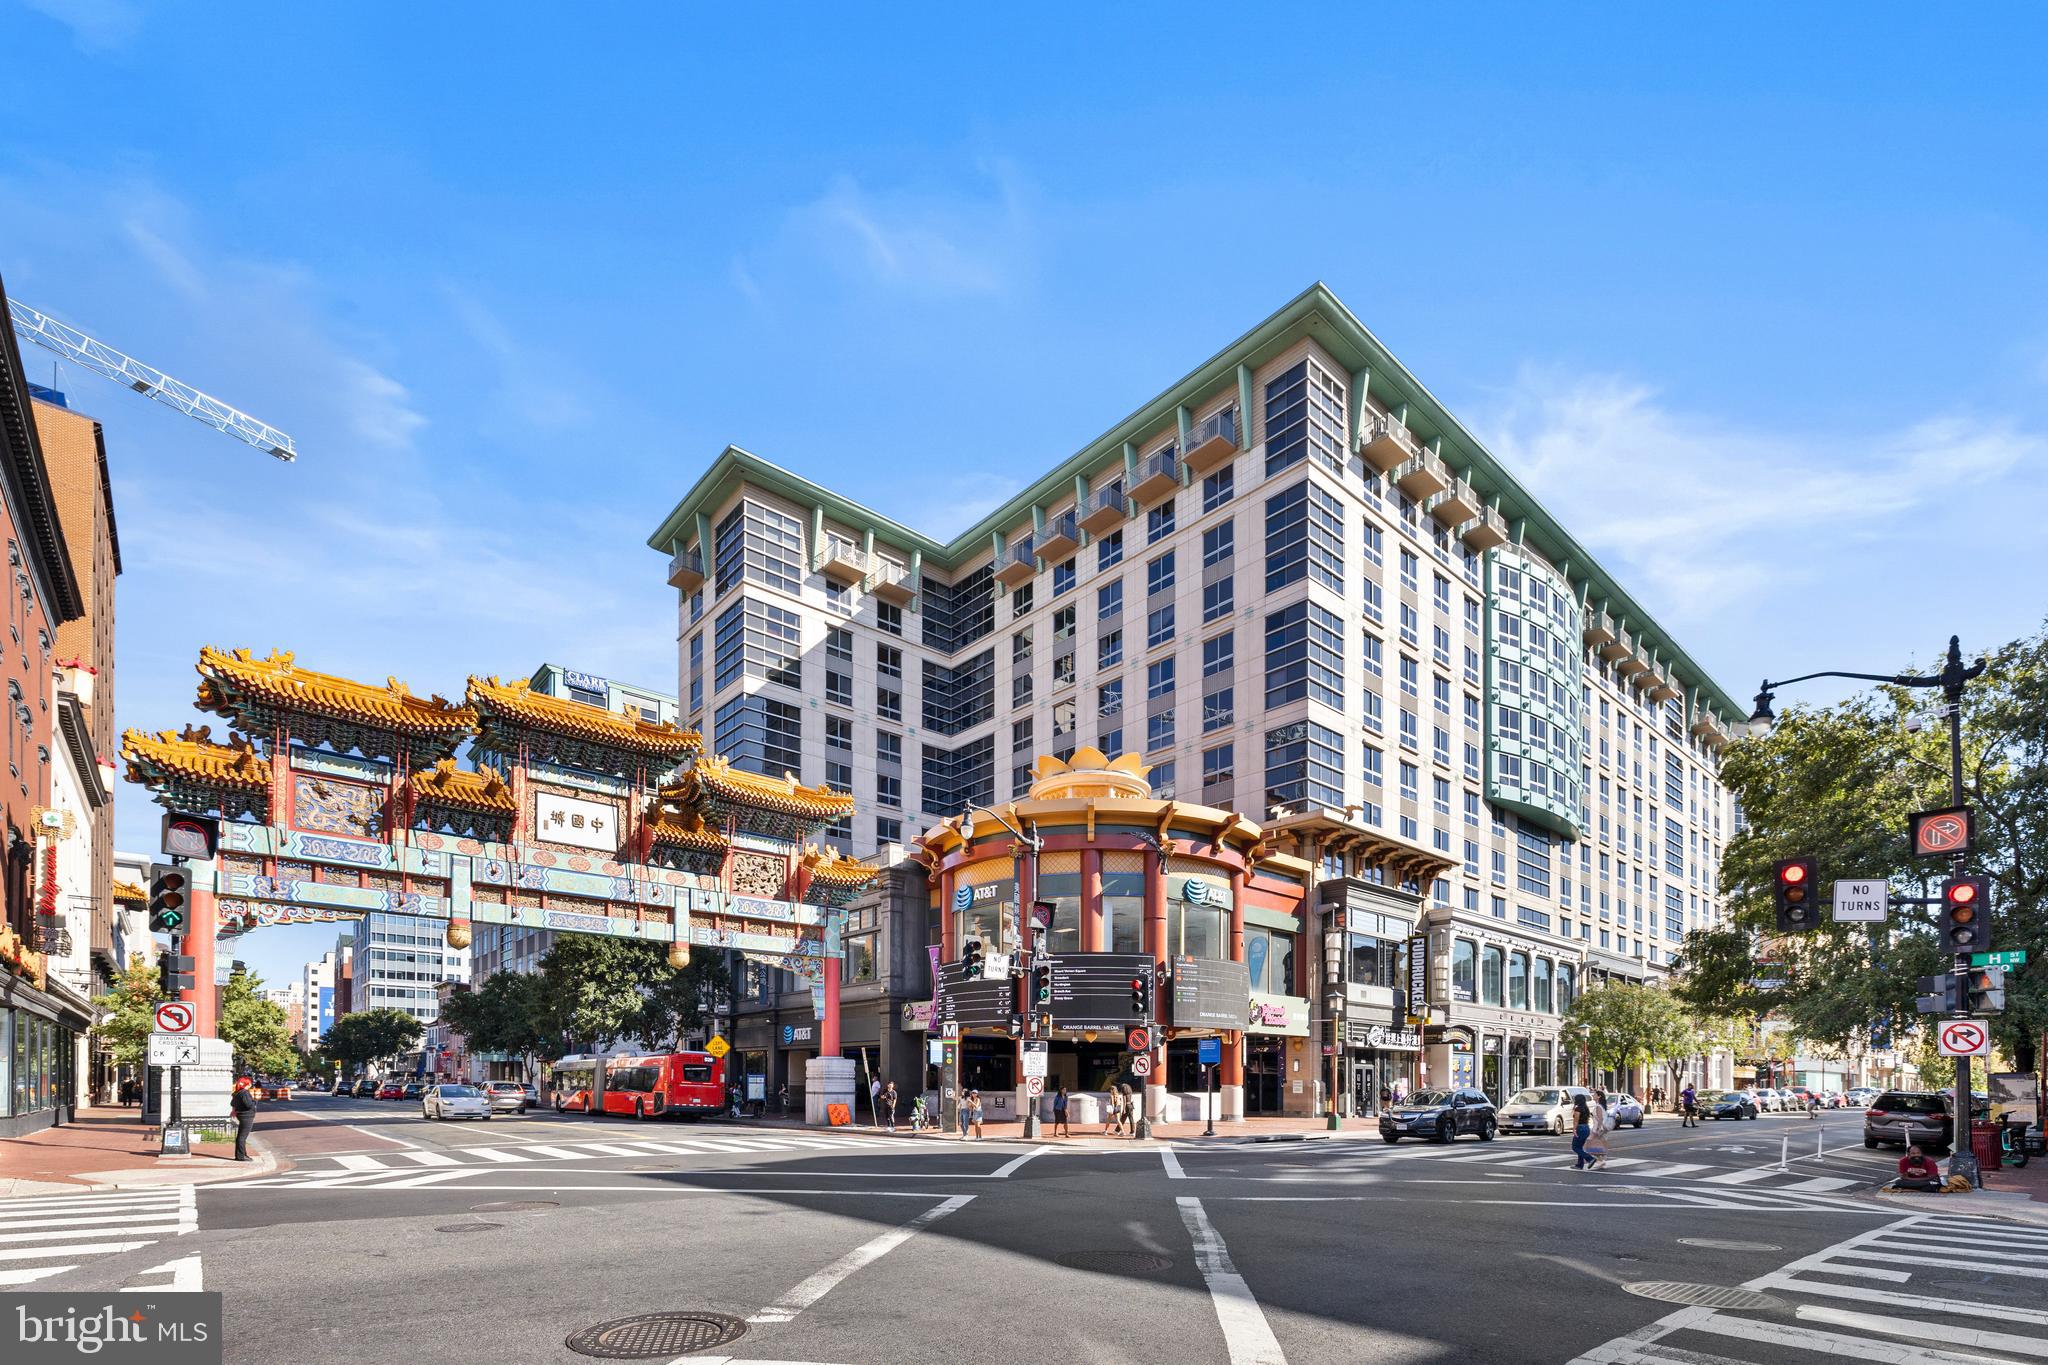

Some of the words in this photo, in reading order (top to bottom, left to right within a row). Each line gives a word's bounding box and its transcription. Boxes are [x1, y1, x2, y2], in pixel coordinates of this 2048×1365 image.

[567, 670, 607, 689] CLARK
[974, 885, 998, 900] AT&T
[1208, 888, 1228, 902] AT&T
[1852, 885, 1869, 895] NO
[1841, 901, 1880, 911] TURNS
[1989, 953, 2001, 964] H
[988, 965, 1005, 973] TURNS
[793, 1027, 813, 1040] AT&T
[943, 1024, 956, 1037] M
